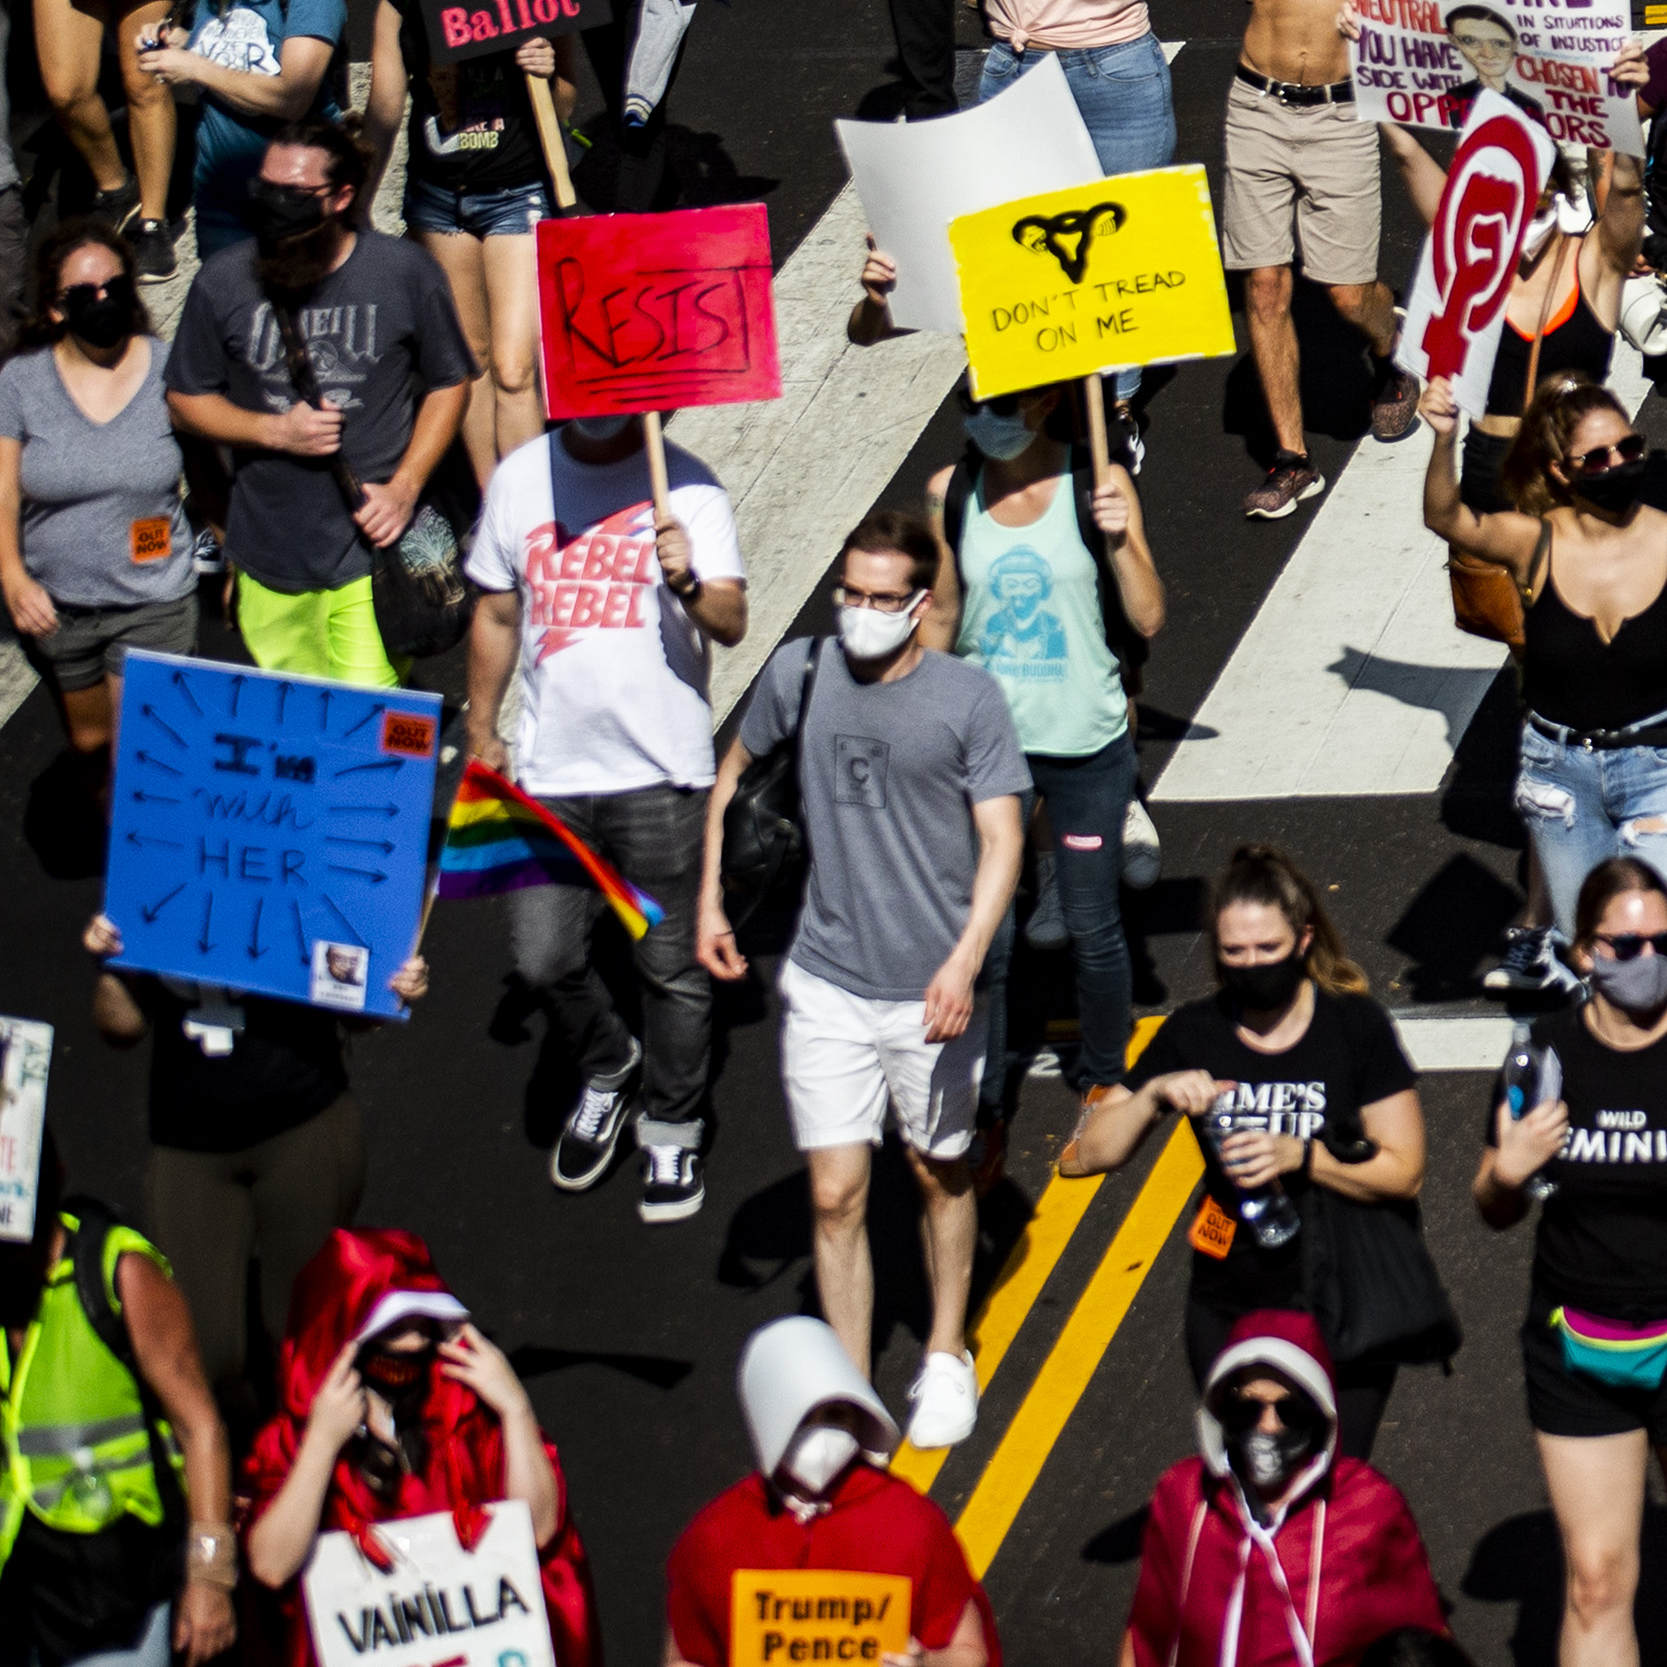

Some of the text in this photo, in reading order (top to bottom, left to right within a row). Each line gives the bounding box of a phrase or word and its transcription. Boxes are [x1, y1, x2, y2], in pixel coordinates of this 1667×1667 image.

[557, 255, 751, 371] RESIST
[990, 270, 1186, 333] DON'T TREAD
[1035, 308, 1141, 353] ON ME
[527, 528, 656, 586] REBEL
[529, 587, 647, 629] REBEL
